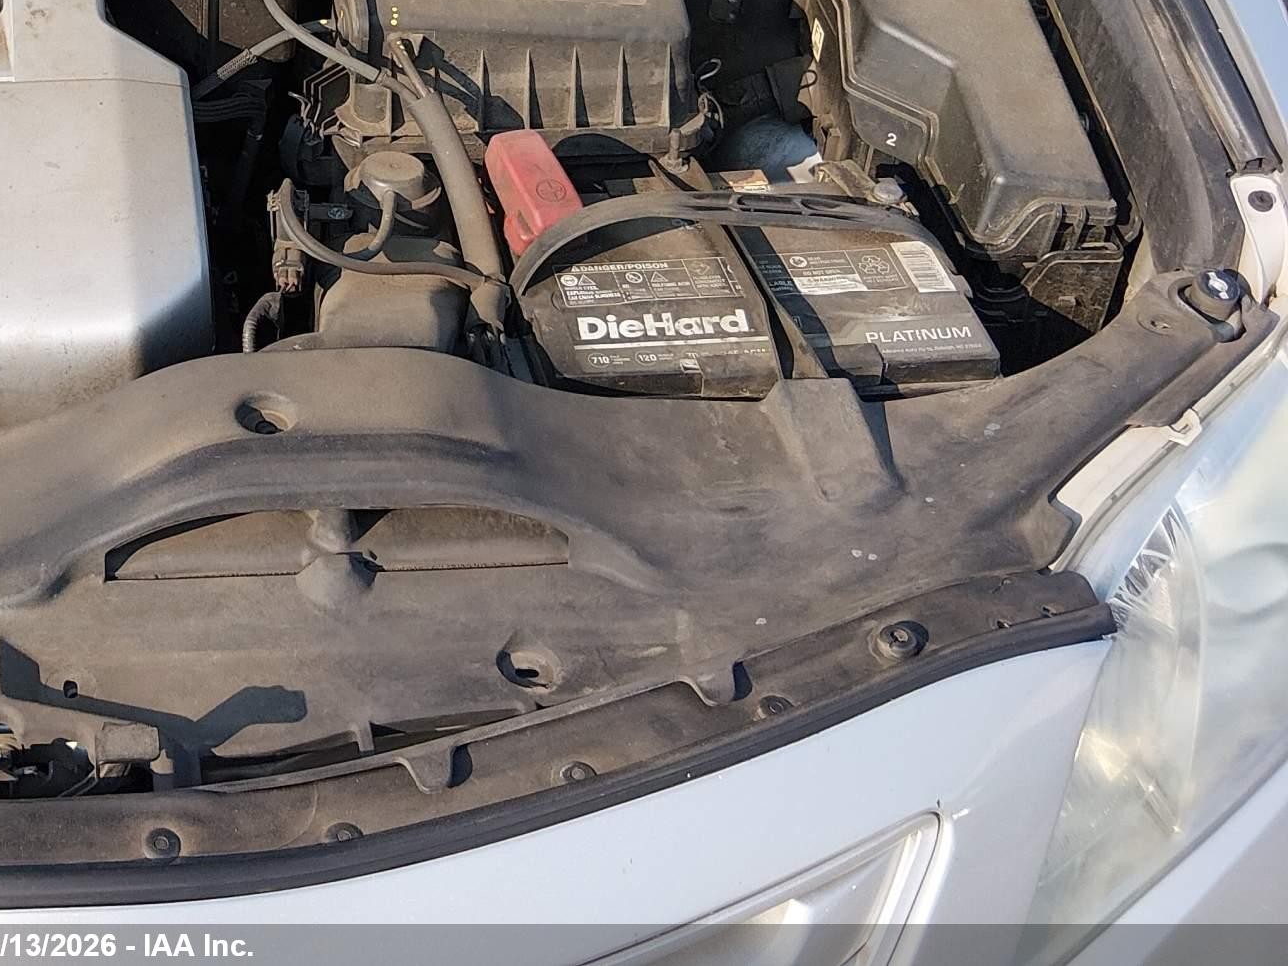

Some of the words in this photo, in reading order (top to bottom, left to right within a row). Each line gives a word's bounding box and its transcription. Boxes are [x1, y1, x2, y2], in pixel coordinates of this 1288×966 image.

[885, 133, 897, 146] 2
[580, 262, 669, 272] DANGER/POISON
[577, 309, 749, 340] DieHard
[865, 326, 972, 343] PLATINUM
[591, 356, 610, 364] 710
[638, 354, 657, 362] 120
